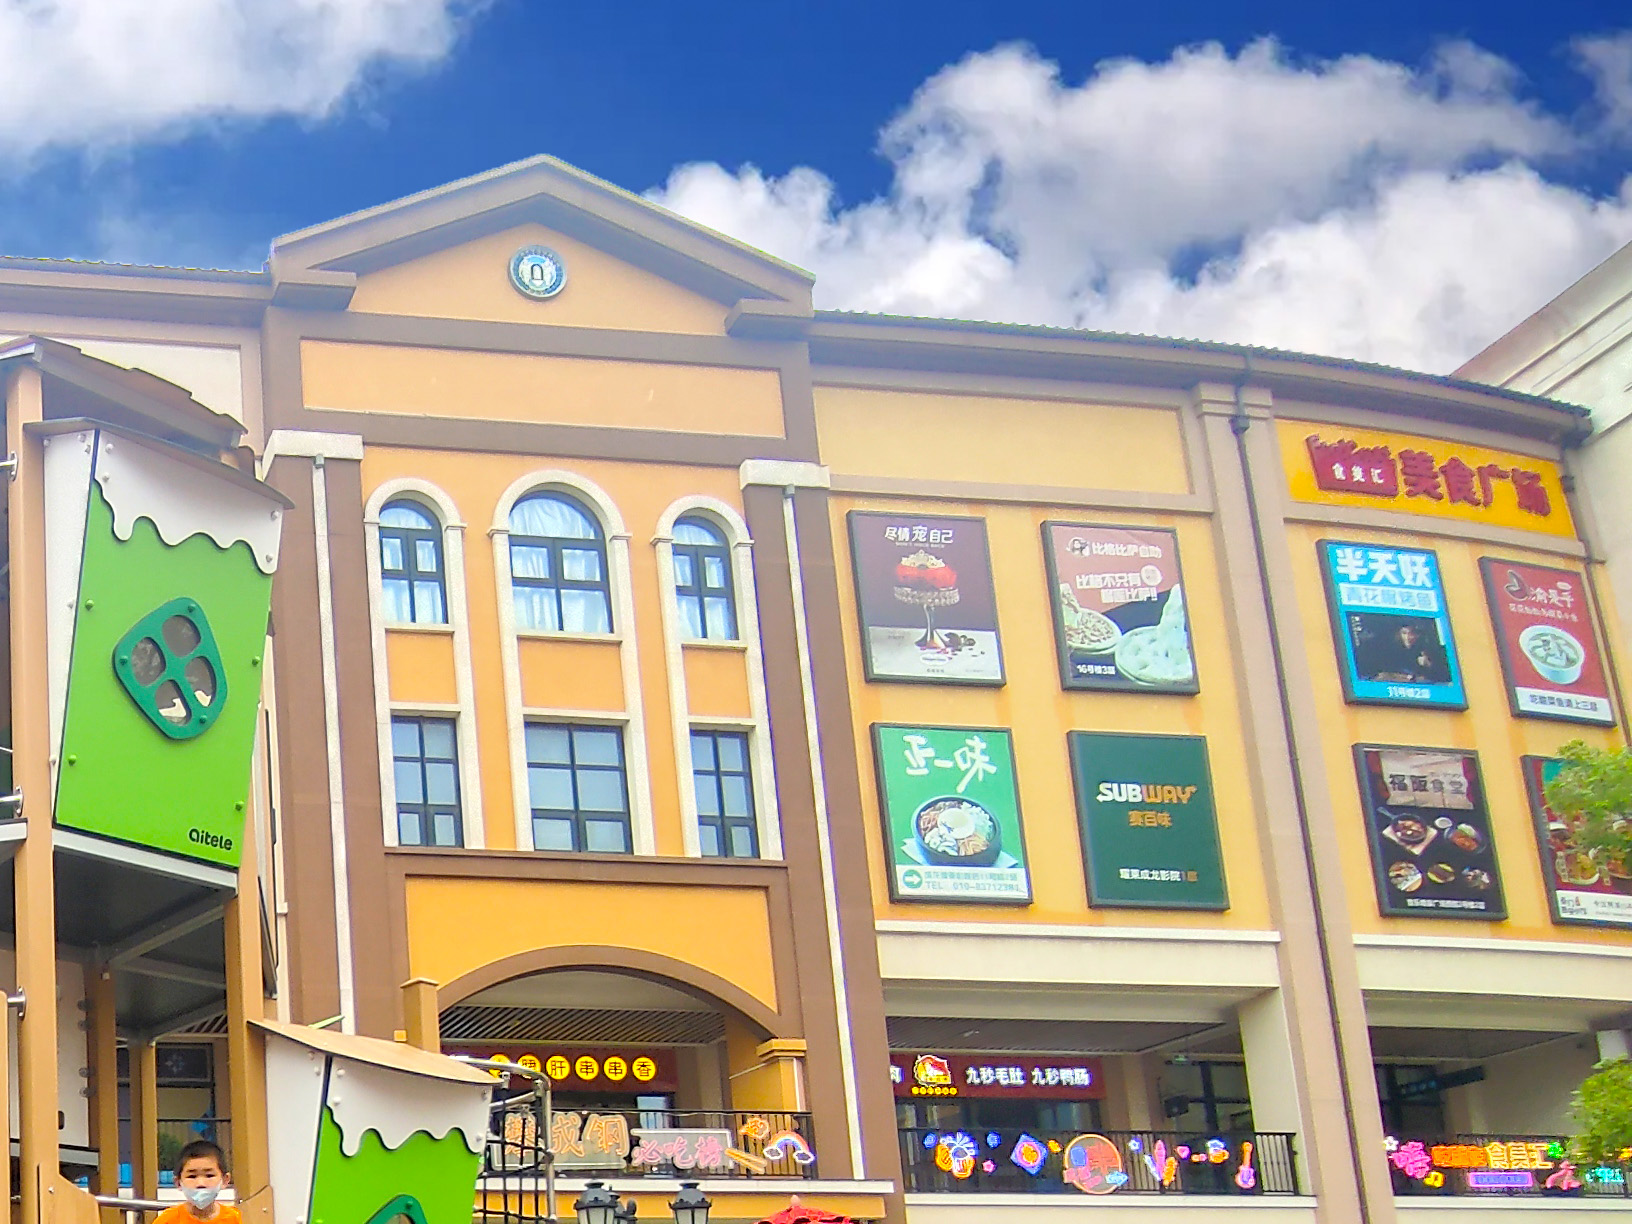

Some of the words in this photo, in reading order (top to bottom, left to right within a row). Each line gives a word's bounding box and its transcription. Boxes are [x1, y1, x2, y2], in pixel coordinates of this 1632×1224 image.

[1398, 448, 1552, 517] 美食广场
[884, 524, 954, 545] 尽情宠自己
[1335, 548, 1432, 588] 半天妖
[902, 735, 998, 794] 正一味
[1096, 782, 1197, 804] SUBWAY
[632, 1135, 725, 1168] 必吃榜
